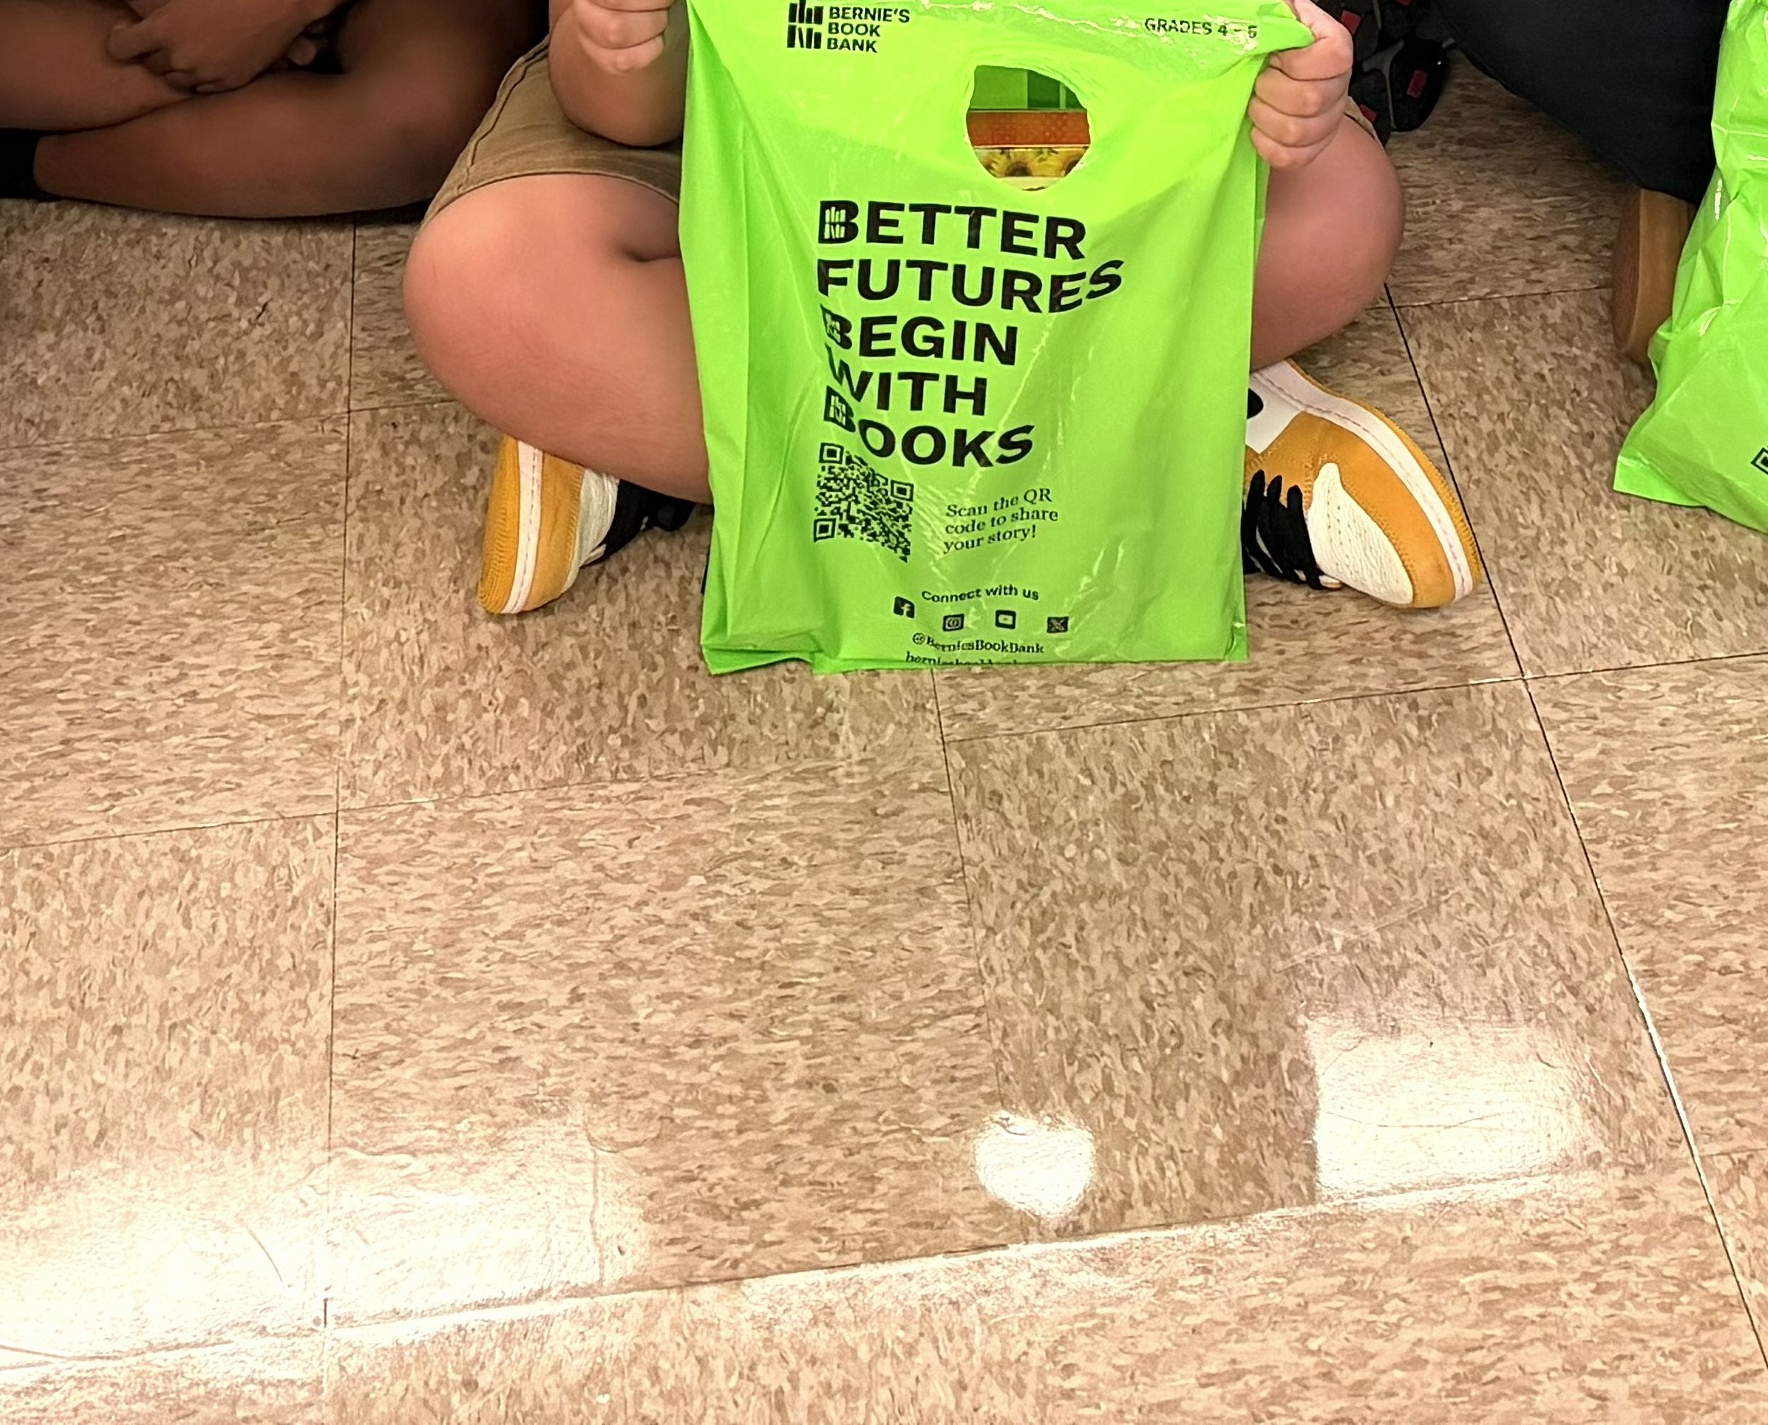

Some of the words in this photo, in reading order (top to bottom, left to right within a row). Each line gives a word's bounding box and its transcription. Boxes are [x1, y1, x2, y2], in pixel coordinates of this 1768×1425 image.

[828, 21, 881, 38] BOOK
[829, 5, 910, 25] BERNIE'S
[827, 36, 878, 54] BANK
[817, 199, 1086, 259] BETTER
[816, 258, 1124, 314] FUTURES
[822, 306, 1018, 366] BEGIN
[827, 343, 987, 416] WITH
[824, 387, 1034, 468] BOOKS
[946, 501, 988, 519] Scan
[994, 493, 1019, 511] the
[1023, 487, 1053, 506] QR
[946, 518, 984, 536] code
[990, 514, 1005, 529] to
[1010, 507, 1059, 525] share
[943, 534, 984, 554] your
[989, 524, 1037, 547] story!
[921, 587, 983, 603] Connect
[986, 584, 1018, 598] with
[1021, 588, 1039, 601] us
